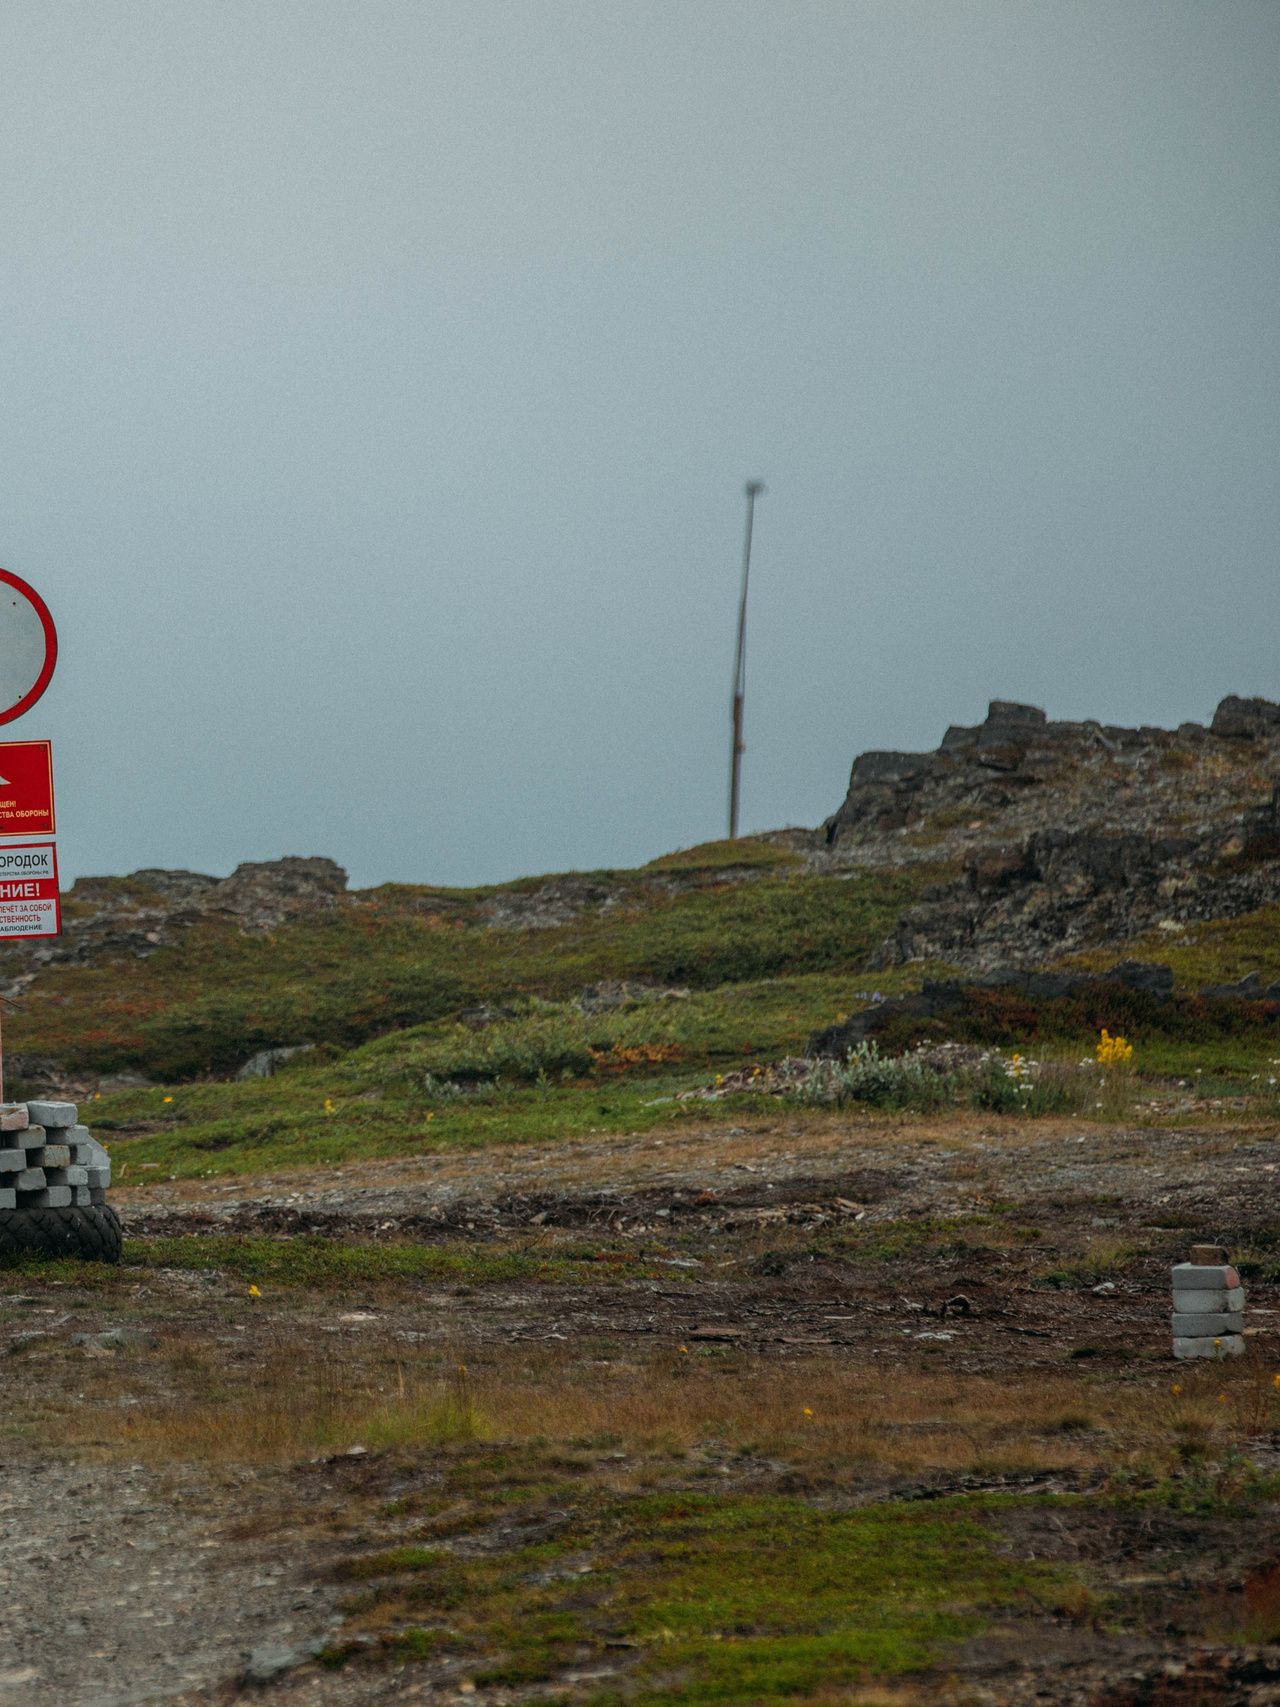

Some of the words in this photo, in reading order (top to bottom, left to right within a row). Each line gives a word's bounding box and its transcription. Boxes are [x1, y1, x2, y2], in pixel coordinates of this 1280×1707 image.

[16, 809, 48, 818] ОБОРОНЫ
[20, 904, 28, 912] ЗА
[30, 902, 52, 911] СОБОЙ
